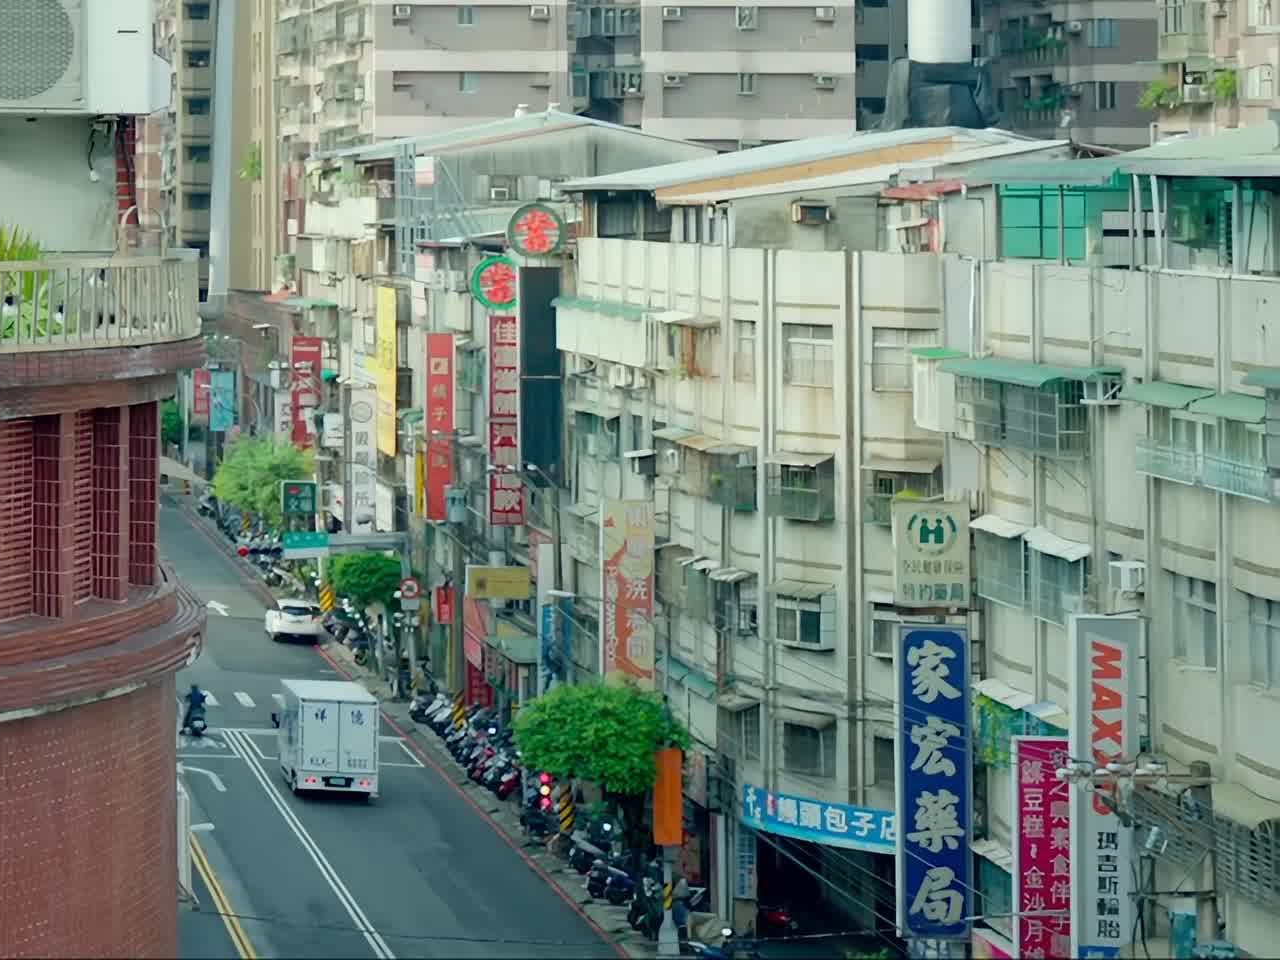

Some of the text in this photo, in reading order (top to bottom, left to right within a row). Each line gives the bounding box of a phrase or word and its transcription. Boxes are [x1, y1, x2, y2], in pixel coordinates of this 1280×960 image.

[907, 641, 964, 926] 家宏藥局
[1096, 831, 1121, 939] 瑪吉斯輪胎
